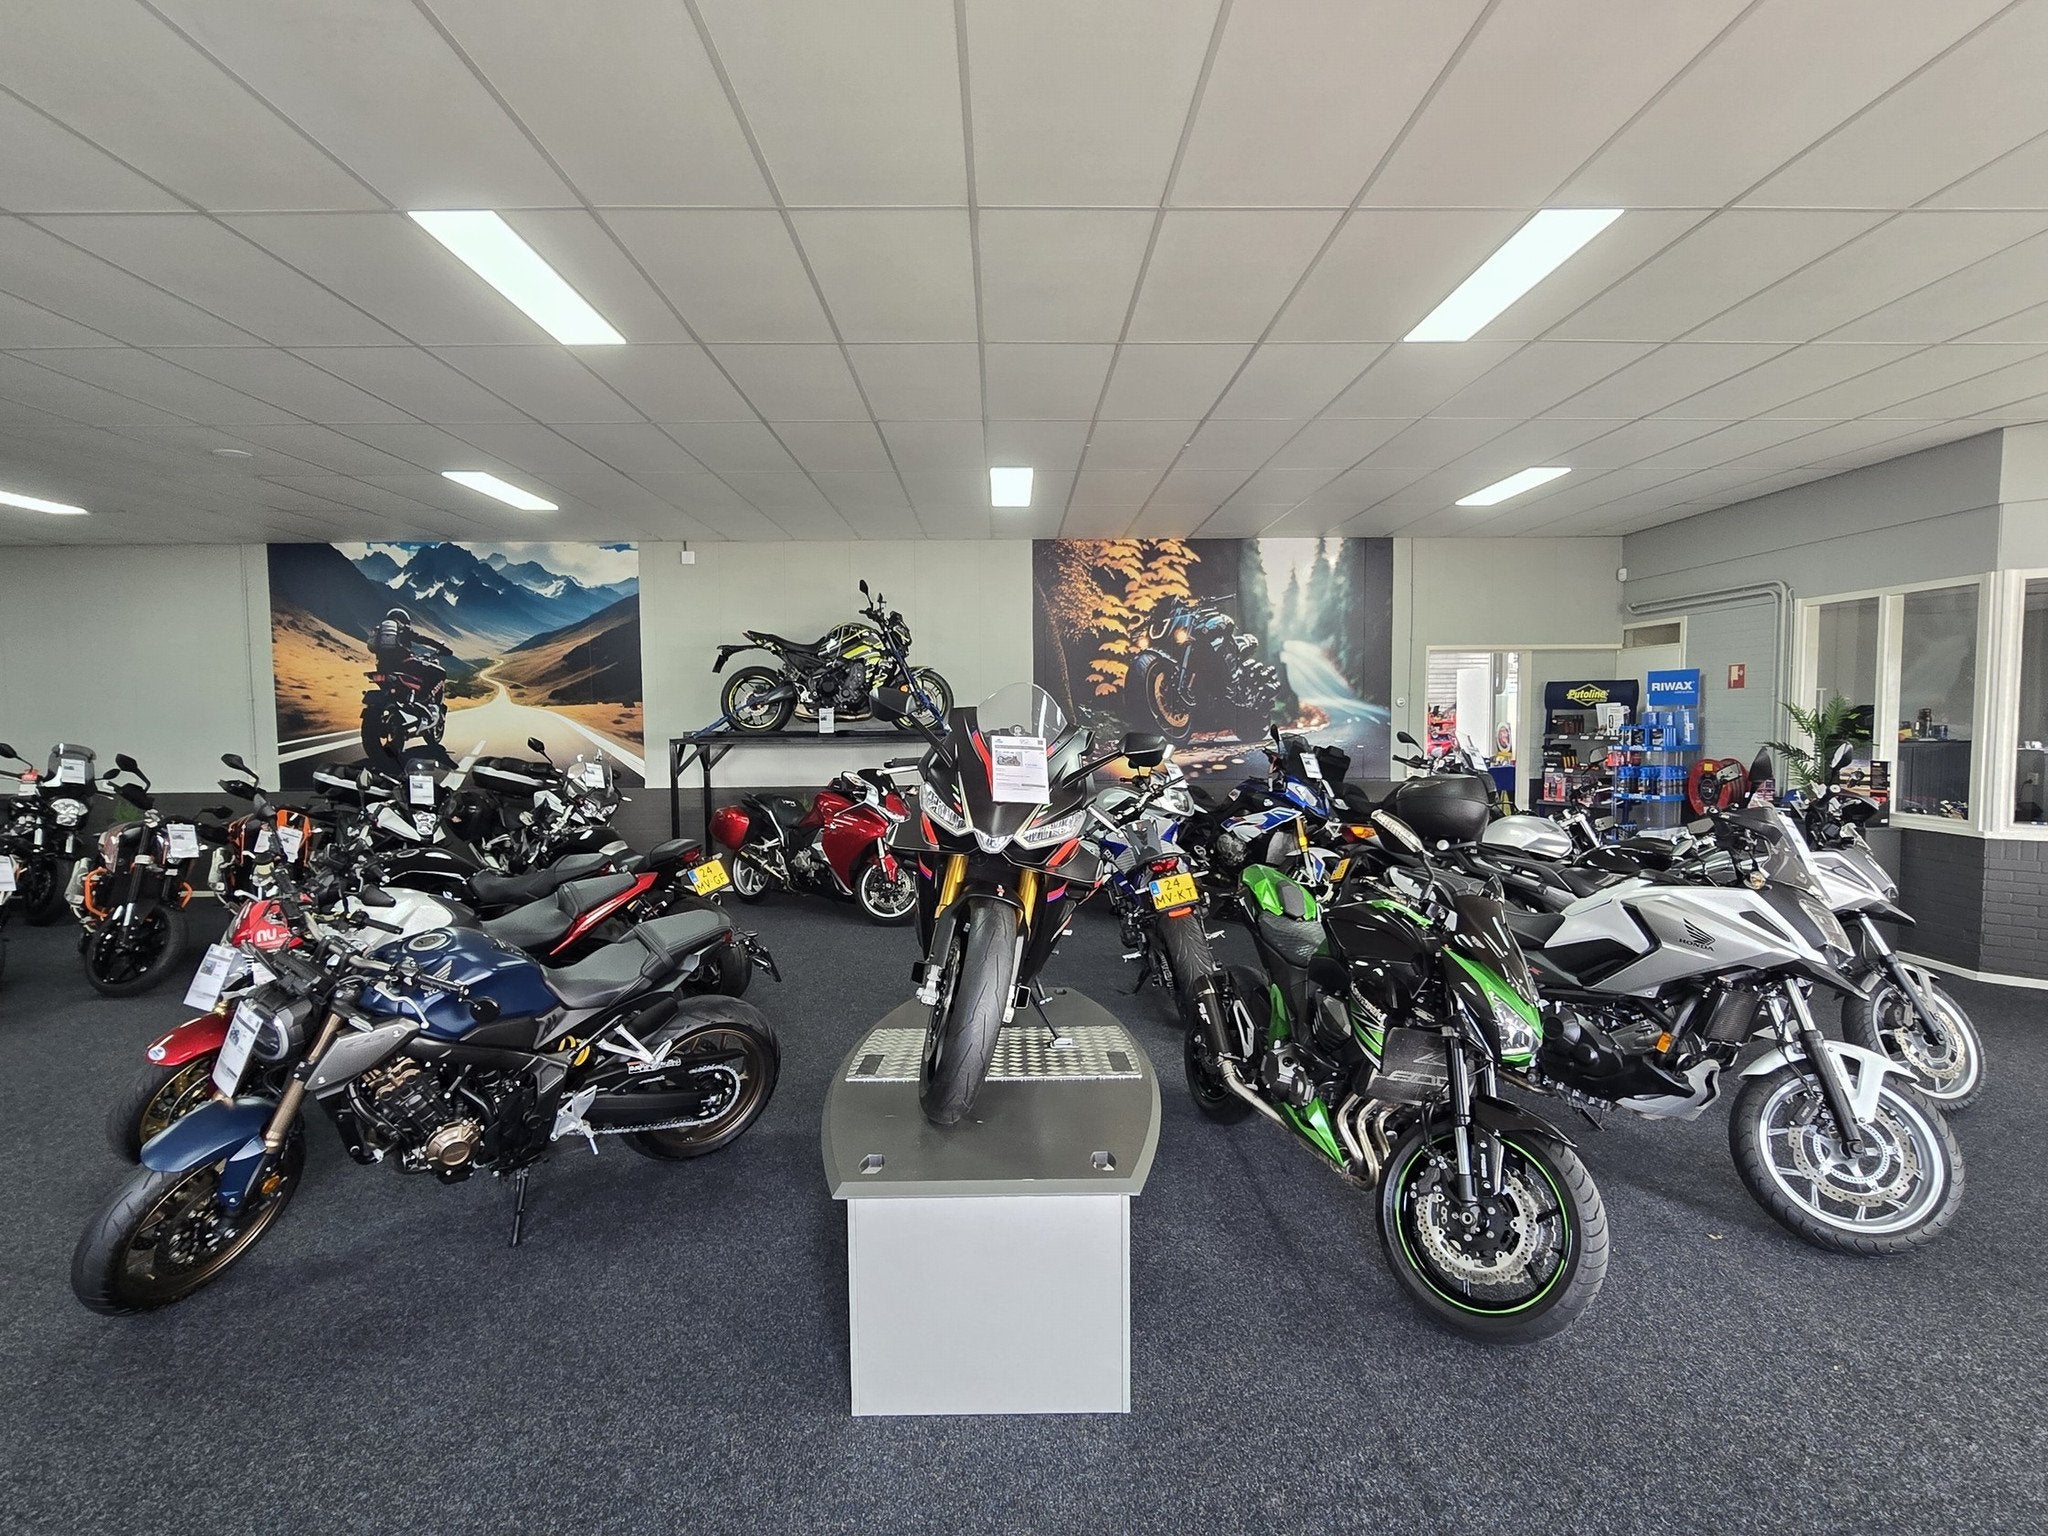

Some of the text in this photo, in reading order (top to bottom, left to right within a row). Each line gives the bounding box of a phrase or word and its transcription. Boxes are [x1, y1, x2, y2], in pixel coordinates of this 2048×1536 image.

[1651, 681, 1693, 691] RIWAX
[699, 866, 713, 878] 24
[1164, 878, 1181, 890] 24
[1678, 938, 1715, 952] HONDA
